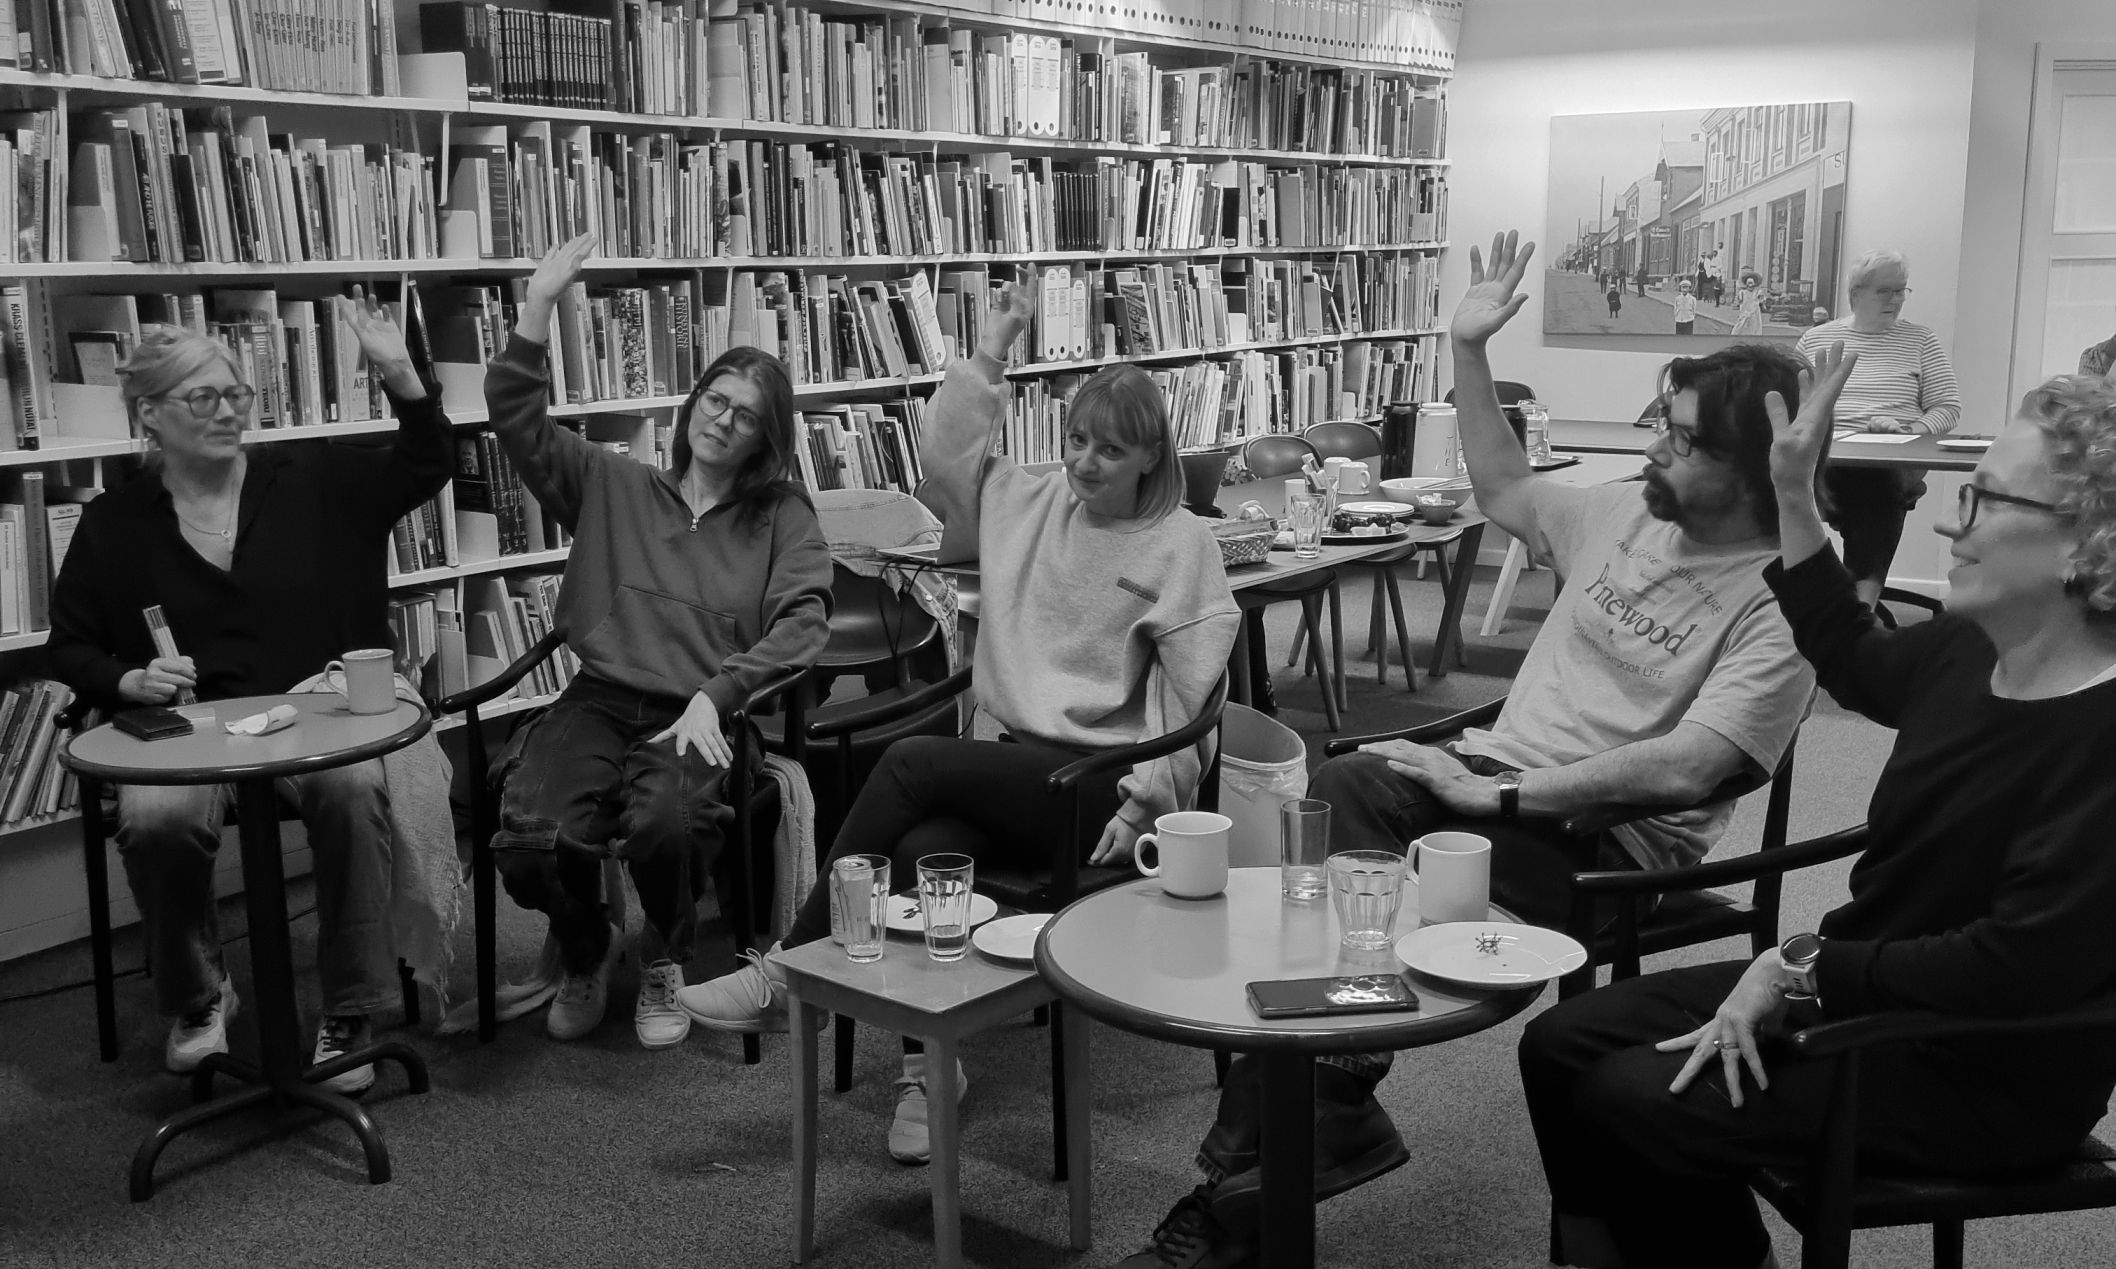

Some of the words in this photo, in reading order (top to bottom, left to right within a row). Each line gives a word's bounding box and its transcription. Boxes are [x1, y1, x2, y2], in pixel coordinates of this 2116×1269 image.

[10, 303, 23, 330] KRASS
[1670, 565, 1697, 585] OUR
[1642, 666, 1665, 679] LIFE
